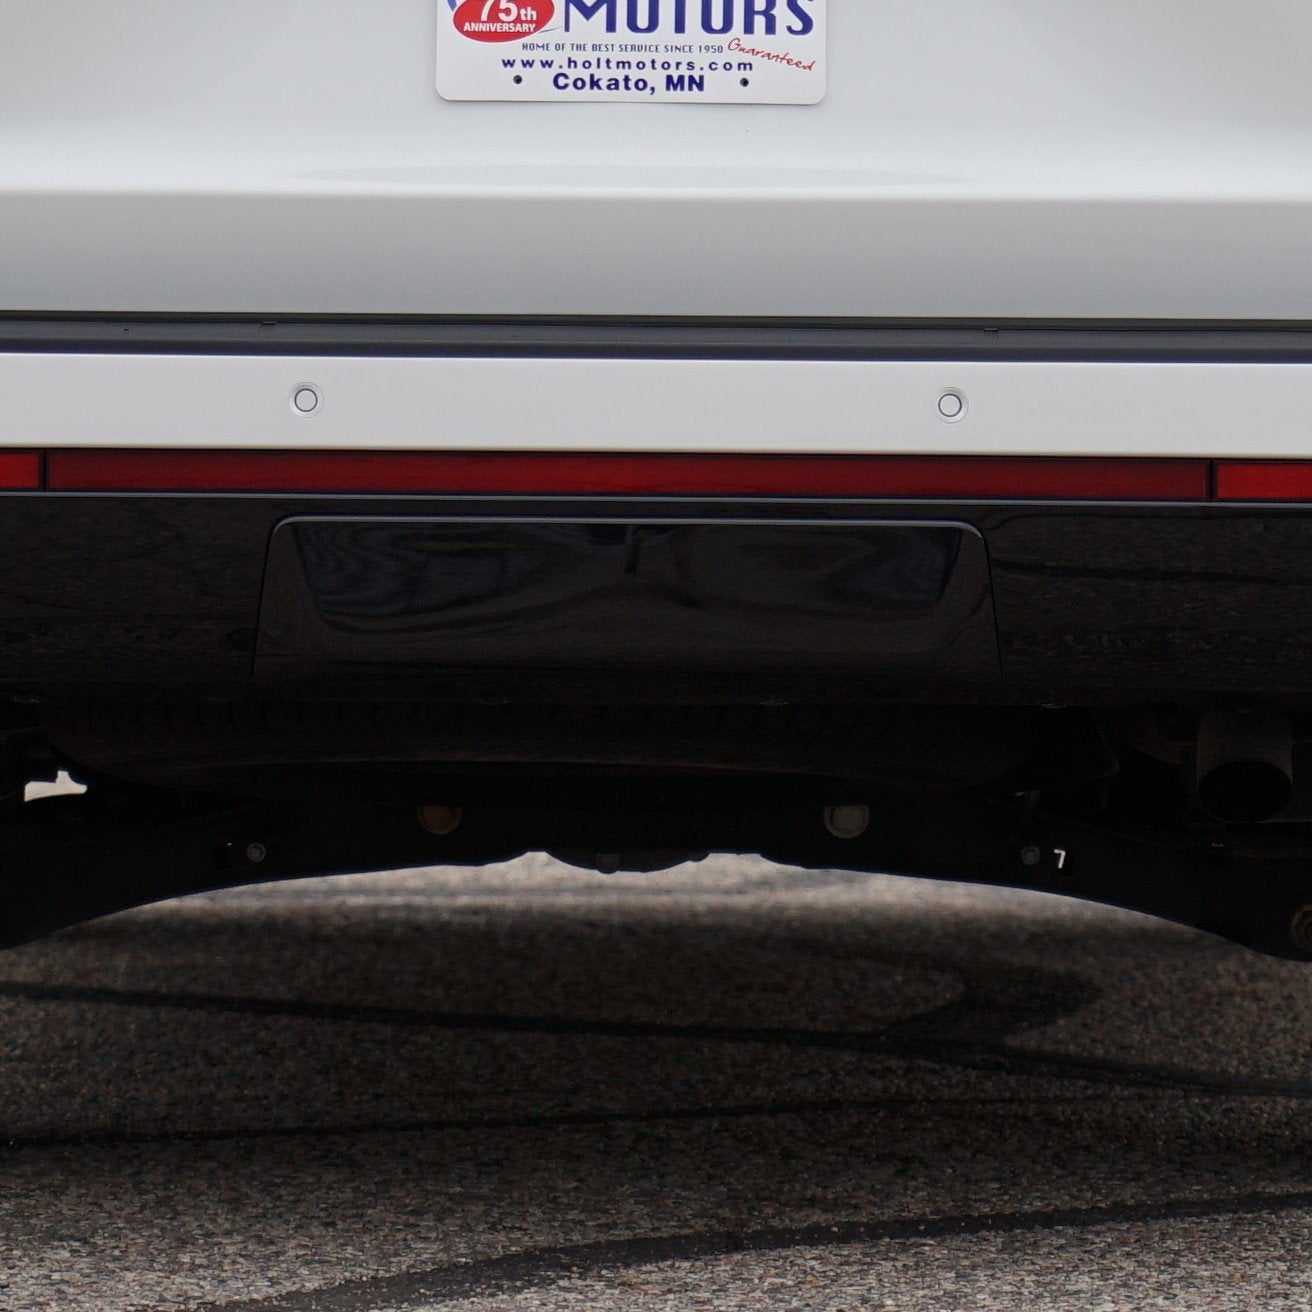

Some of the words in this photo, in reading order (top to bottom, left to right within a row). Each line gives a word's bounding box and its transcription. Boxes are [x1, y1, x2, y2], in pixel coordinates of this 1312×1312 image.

[463, 21, 536, 33] ANNIVERSARY
[522, 42, 550, 52] HOME
[554, 42, 566, 52] OF
[569, 42, 588, 52] THE
[591, 43, 615, 53] BEST
[618, 43, 660, 54] SERVICE
[664, 44, 694, 54] SINCE
[698, 45, 724, 54] 1950
[727, 38, 816, 72] Guaranteed
[501, 57, 754, 72] www.holtmotors.com
[552, 72, 656, 96] Cokato,
[665, 74, 705, 92] MN
